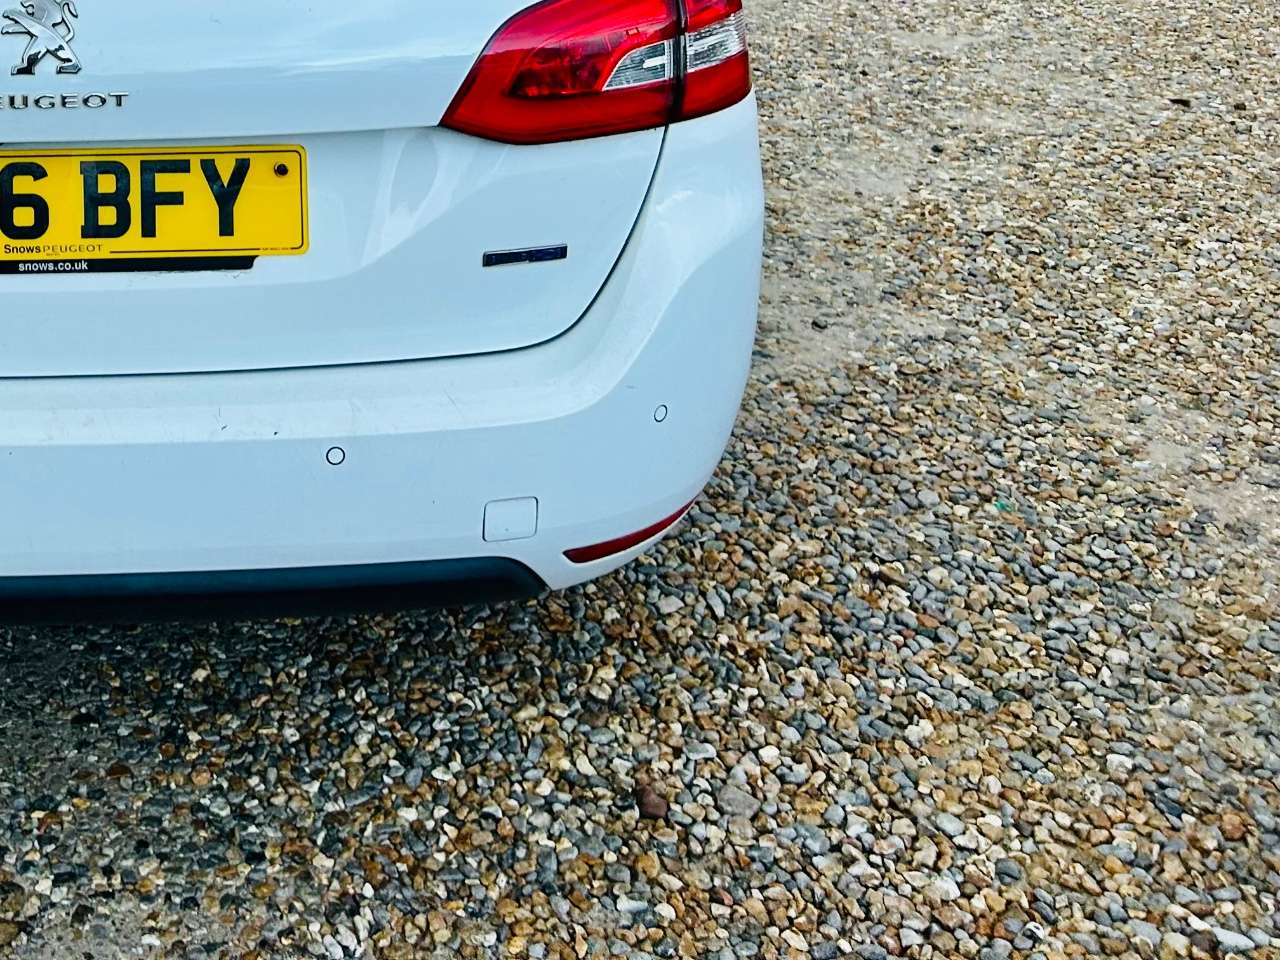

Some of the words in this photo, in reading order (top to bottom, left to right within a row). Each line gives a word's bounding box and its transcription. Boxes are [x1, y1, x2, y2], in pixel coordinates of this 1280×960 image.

[80, 158, 251, 240] BFY
[4, 244, 41, 254] Snows
[42, 244, 103, 253] PEUGEOT
[18, 260, 88, 271] snows.co.uk
